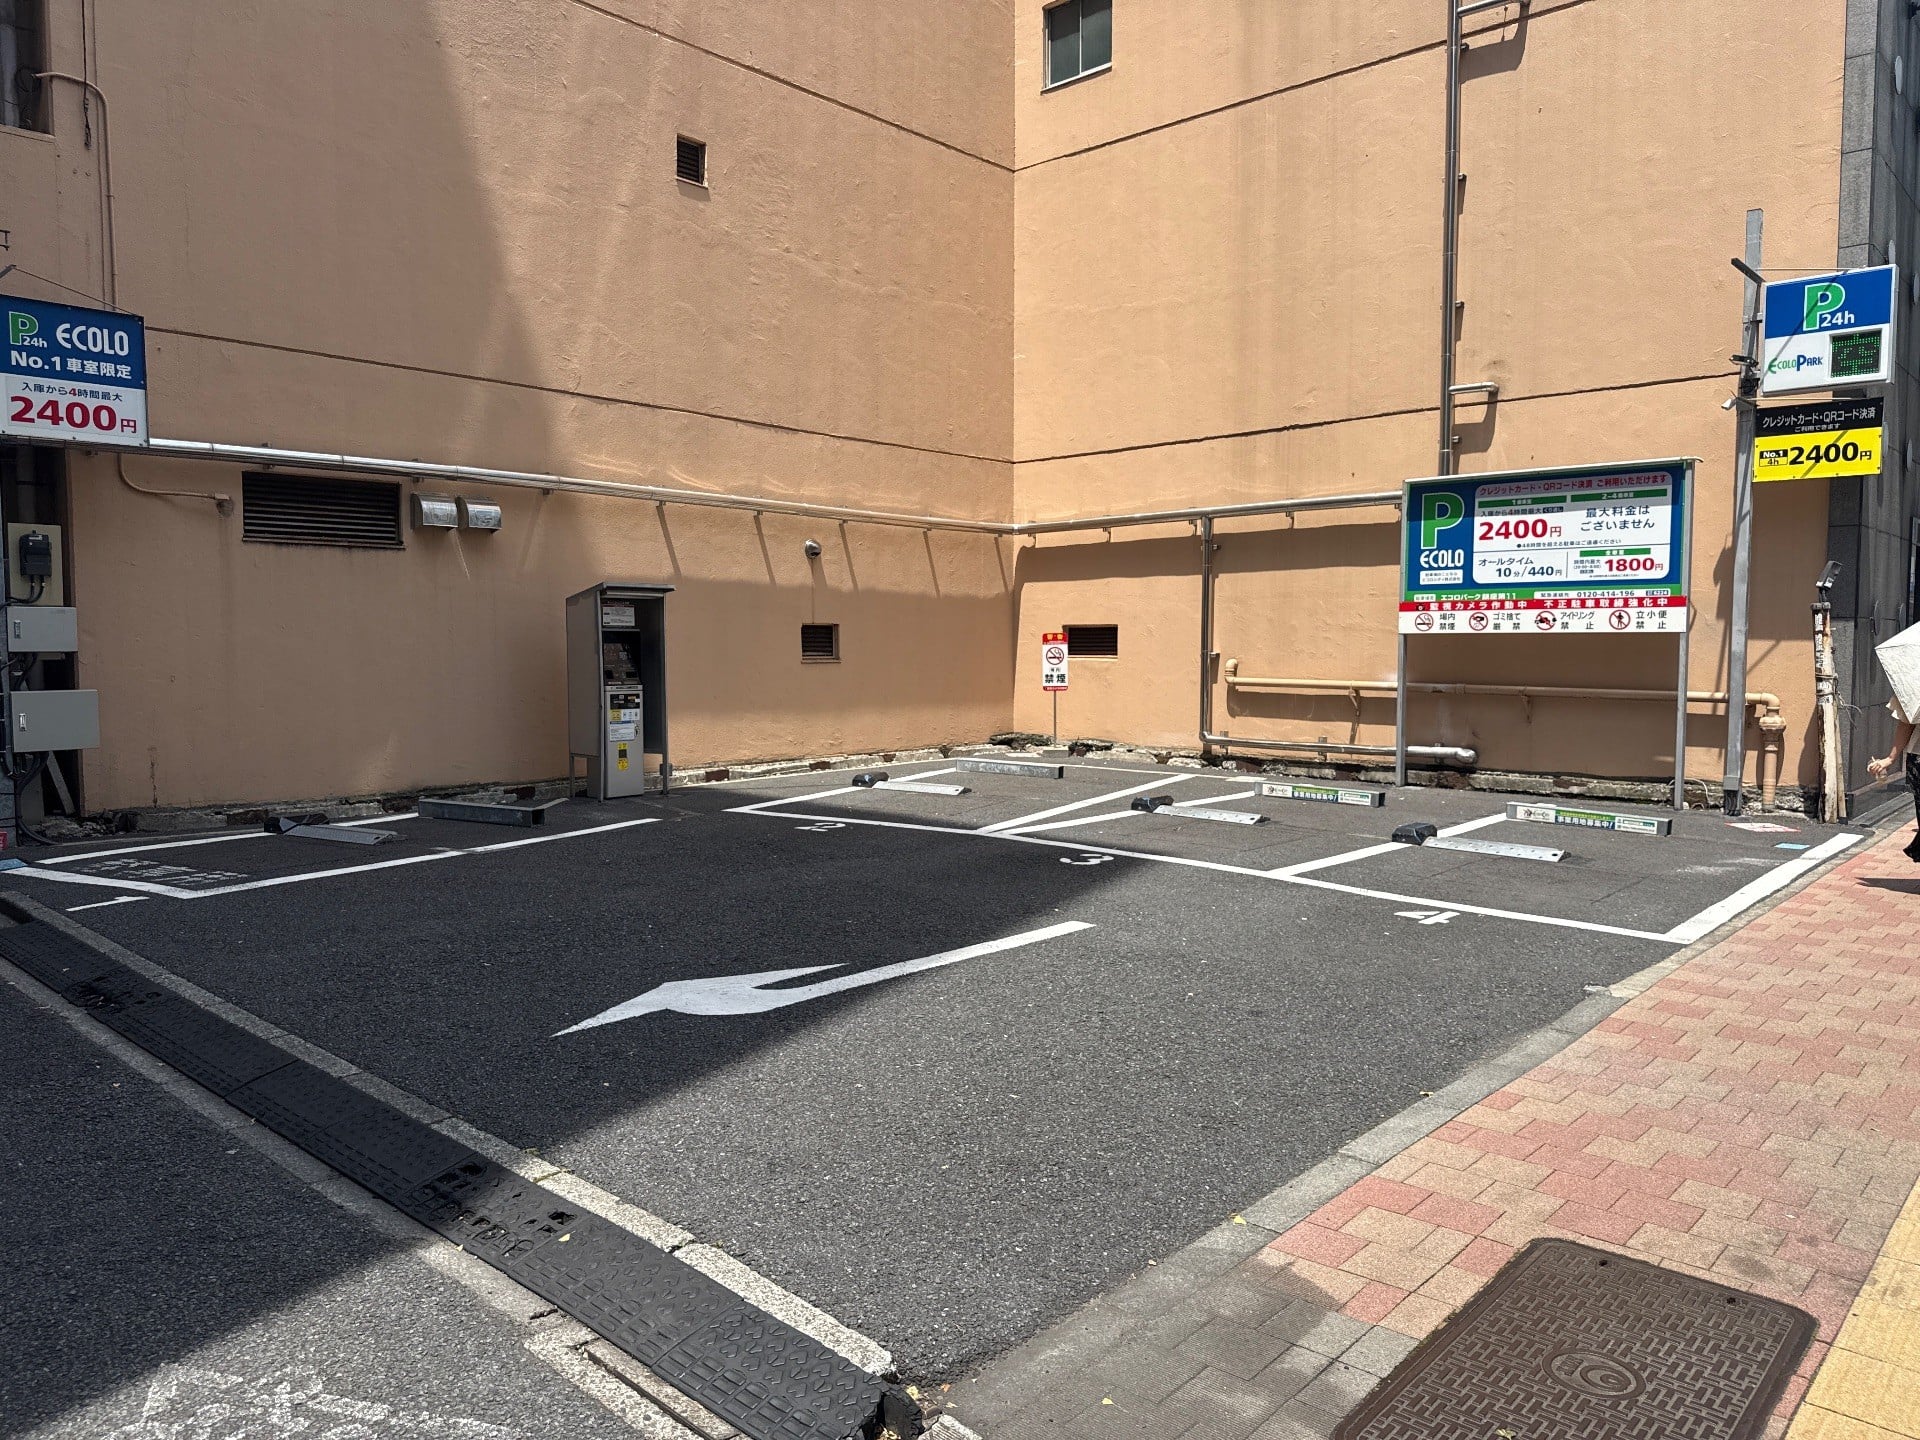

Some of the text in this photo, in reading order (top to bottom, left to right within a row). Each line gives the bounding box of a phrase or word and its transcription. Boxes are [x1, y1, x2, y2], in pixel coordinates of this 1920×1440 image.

[1803, 283, 1846, 332] P
[1820, 311, 1855, 328] 24h
[9, 311, 129, 356] P 24h ECOLO
[22, 382, 123, 402] 入庫から4時間最大
[10, 396, 137, 434] 2400円
[1762, 407, 1876, 428] クレジットカード・QRコード決済
[1763, 451, 1784, 459] No.1
[1789, 442, 1872, 465] 2400円
[1767, 458, 1779, 466] 4h
[1480, 480, 1593, 495] クレジットカード・QRコード決済
[1586, 505, 1650, 518] 最大料金は
[1421, 492, 1465, 549] P
[1580, 519, 1655, 531] ございません
[1479, 519, 1562, 541] 2400円
[1420, 549, 1465, 568] ECOLO
[1478, 557, 1534, 567] オールタイム
[1576, 590, 1635, 598] 0120-414-196
[1430, 601, 1527, 611] 監視カメラ作動中
[1560, 611, 1595, 620] アイドリング
[1636, 610, 1667, 619] 立小便
[1439, 623, 1456, 631] 禁煙
[1045, 674, 1066, 684] 禁煙
[794, 822, 847, 832] 2
[1059, 853, 1115, 865] 3
[66, 895, 150, 912] 1
[1393, 910, 1461, 925] 4
